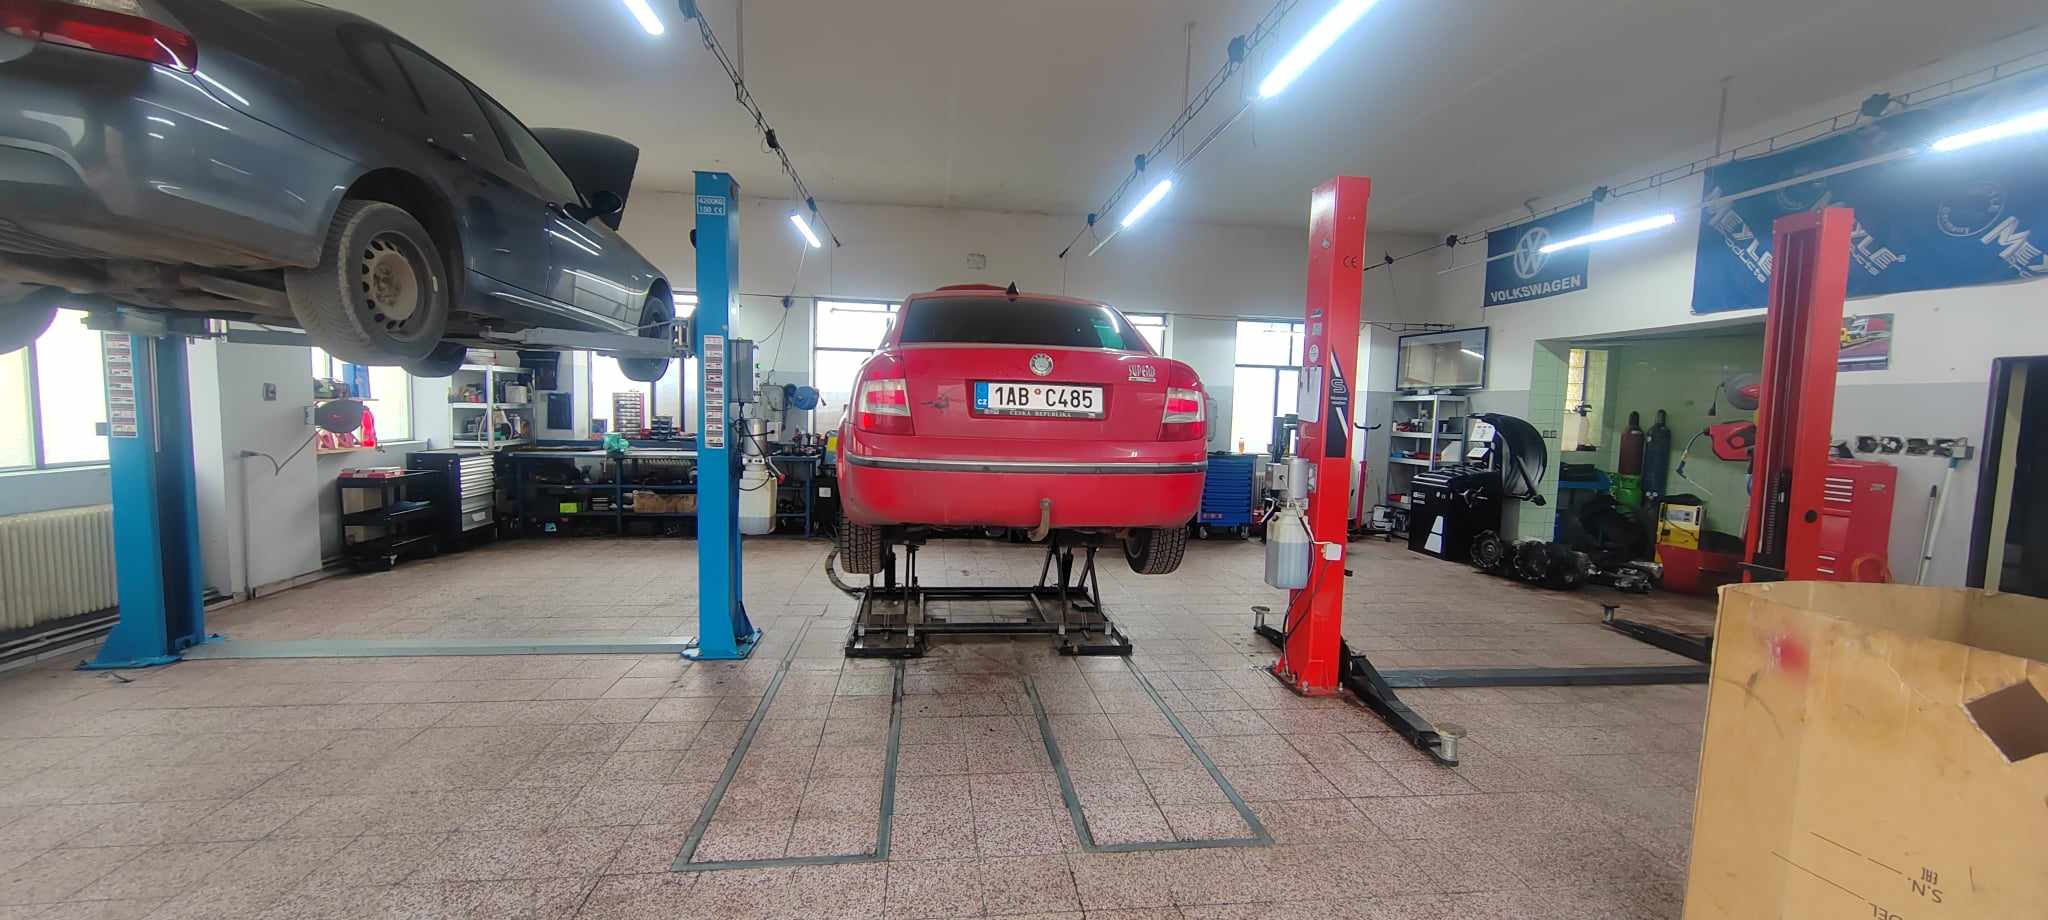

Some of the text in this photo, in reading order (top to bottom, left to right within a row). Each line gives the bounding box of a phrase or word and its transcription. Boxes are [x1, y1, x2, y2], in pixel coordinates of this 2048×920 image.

[1490, 275, 1581, 302] VOLKSWAGEN
[995, 387, 1092, 408] 1AB C485
[1906, 876, 1943, 903] S.N.
